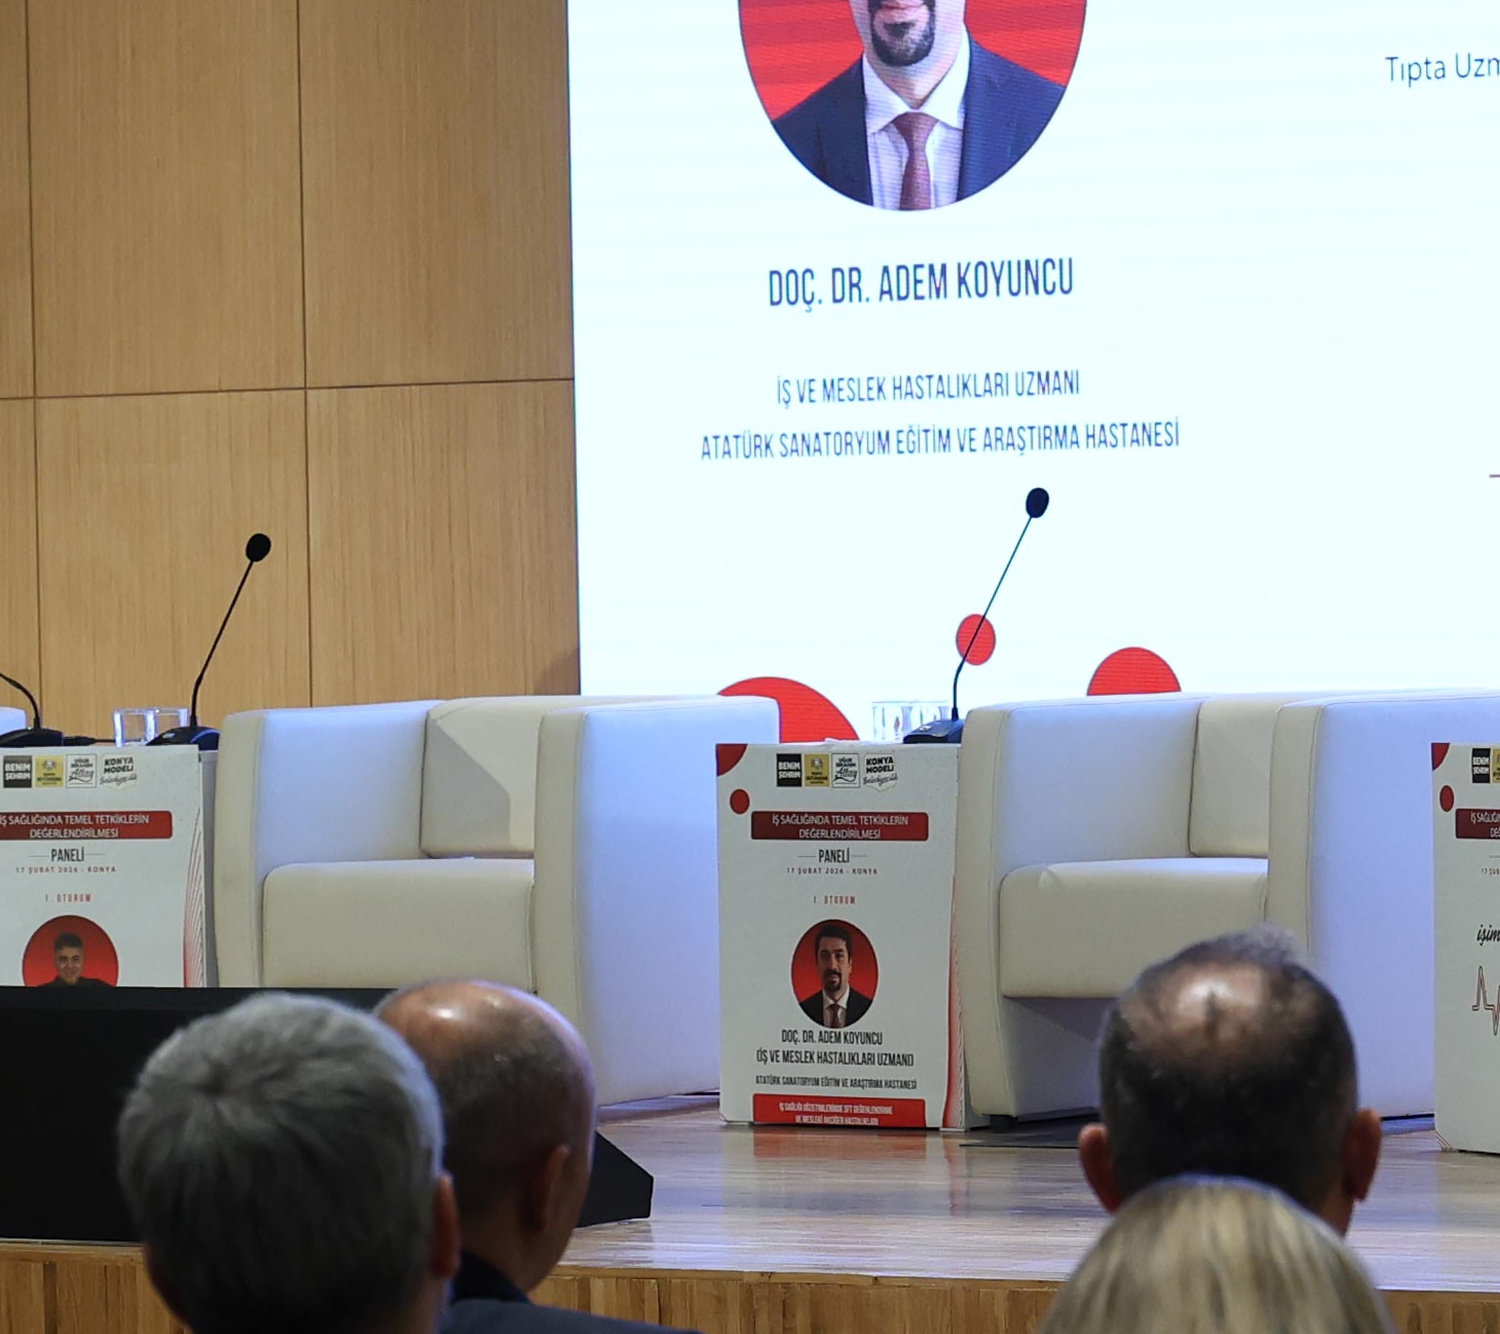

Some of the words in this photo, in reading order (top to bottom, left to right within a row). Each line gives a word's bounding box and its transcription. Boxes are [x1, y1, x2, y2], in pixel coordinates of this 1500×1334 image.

[1385, 56, 1446, 88] Tıpta
[769, 268, 822, 313] DOÇ.
[832, 267, 869, 303] DR.
[879, 263, 947, 301] ADEM
[957, 258, 1073, 298] KOYUNCU
[778, 375, 791, 409] İŞ
[797, 379, 816, 403] VE
[822, 377, 886, 402] MESLEK
[893, 372, 1009, 400] HASTALIKLARI
[1016, 370, 1079, 397] UZMANI
[701, 430, 774, 459] ATATÜRK
[780, 430, 890, 458] SANATORYUM
[896, 425, 951, 454] EĞİTİM
[957, 427, 977, 452] VE
[983, 424, 1080, 455] ARAŞTIRMA
[1086, 416, 1179, 448] HASTANESİ
[0, 814, 7, 827] İŞ
[8, 814, 62, 825] SAĞLIĞINDA
[64, 815, 94, 824] TEMEL
[95, 814, 149, 824] TETKİKLERİN
[772, 813, 779, 827] İŞ
[781, 814, 830, 825] SAĞLIĞINDA
[831, 816, 858, 825] TEMEL
[860, 815, 909, 825] TETKİKLERİN
[30, 827, 119, 839] DEĞERLENDİRİLMESİ
[799, 827, 881, 839] DEĞERLENDİRİLMESİ
[51, 846, 85, 862] PANELİ
[819, 848, 850, 863] PANELİ
[782, 1029, 800, 1045] DOÇ.
[803, 1030, 816, 1043] DR.
[818, 1031, 841, 1044] ADEM
[843, 1031, 883, 1045] KOYUNCU
[770, 1051, 780, 1063] VE
[782, 1051, 816, 1064] MESLEK
[817, 1052, 875, 1065] HASTALIKLARI
